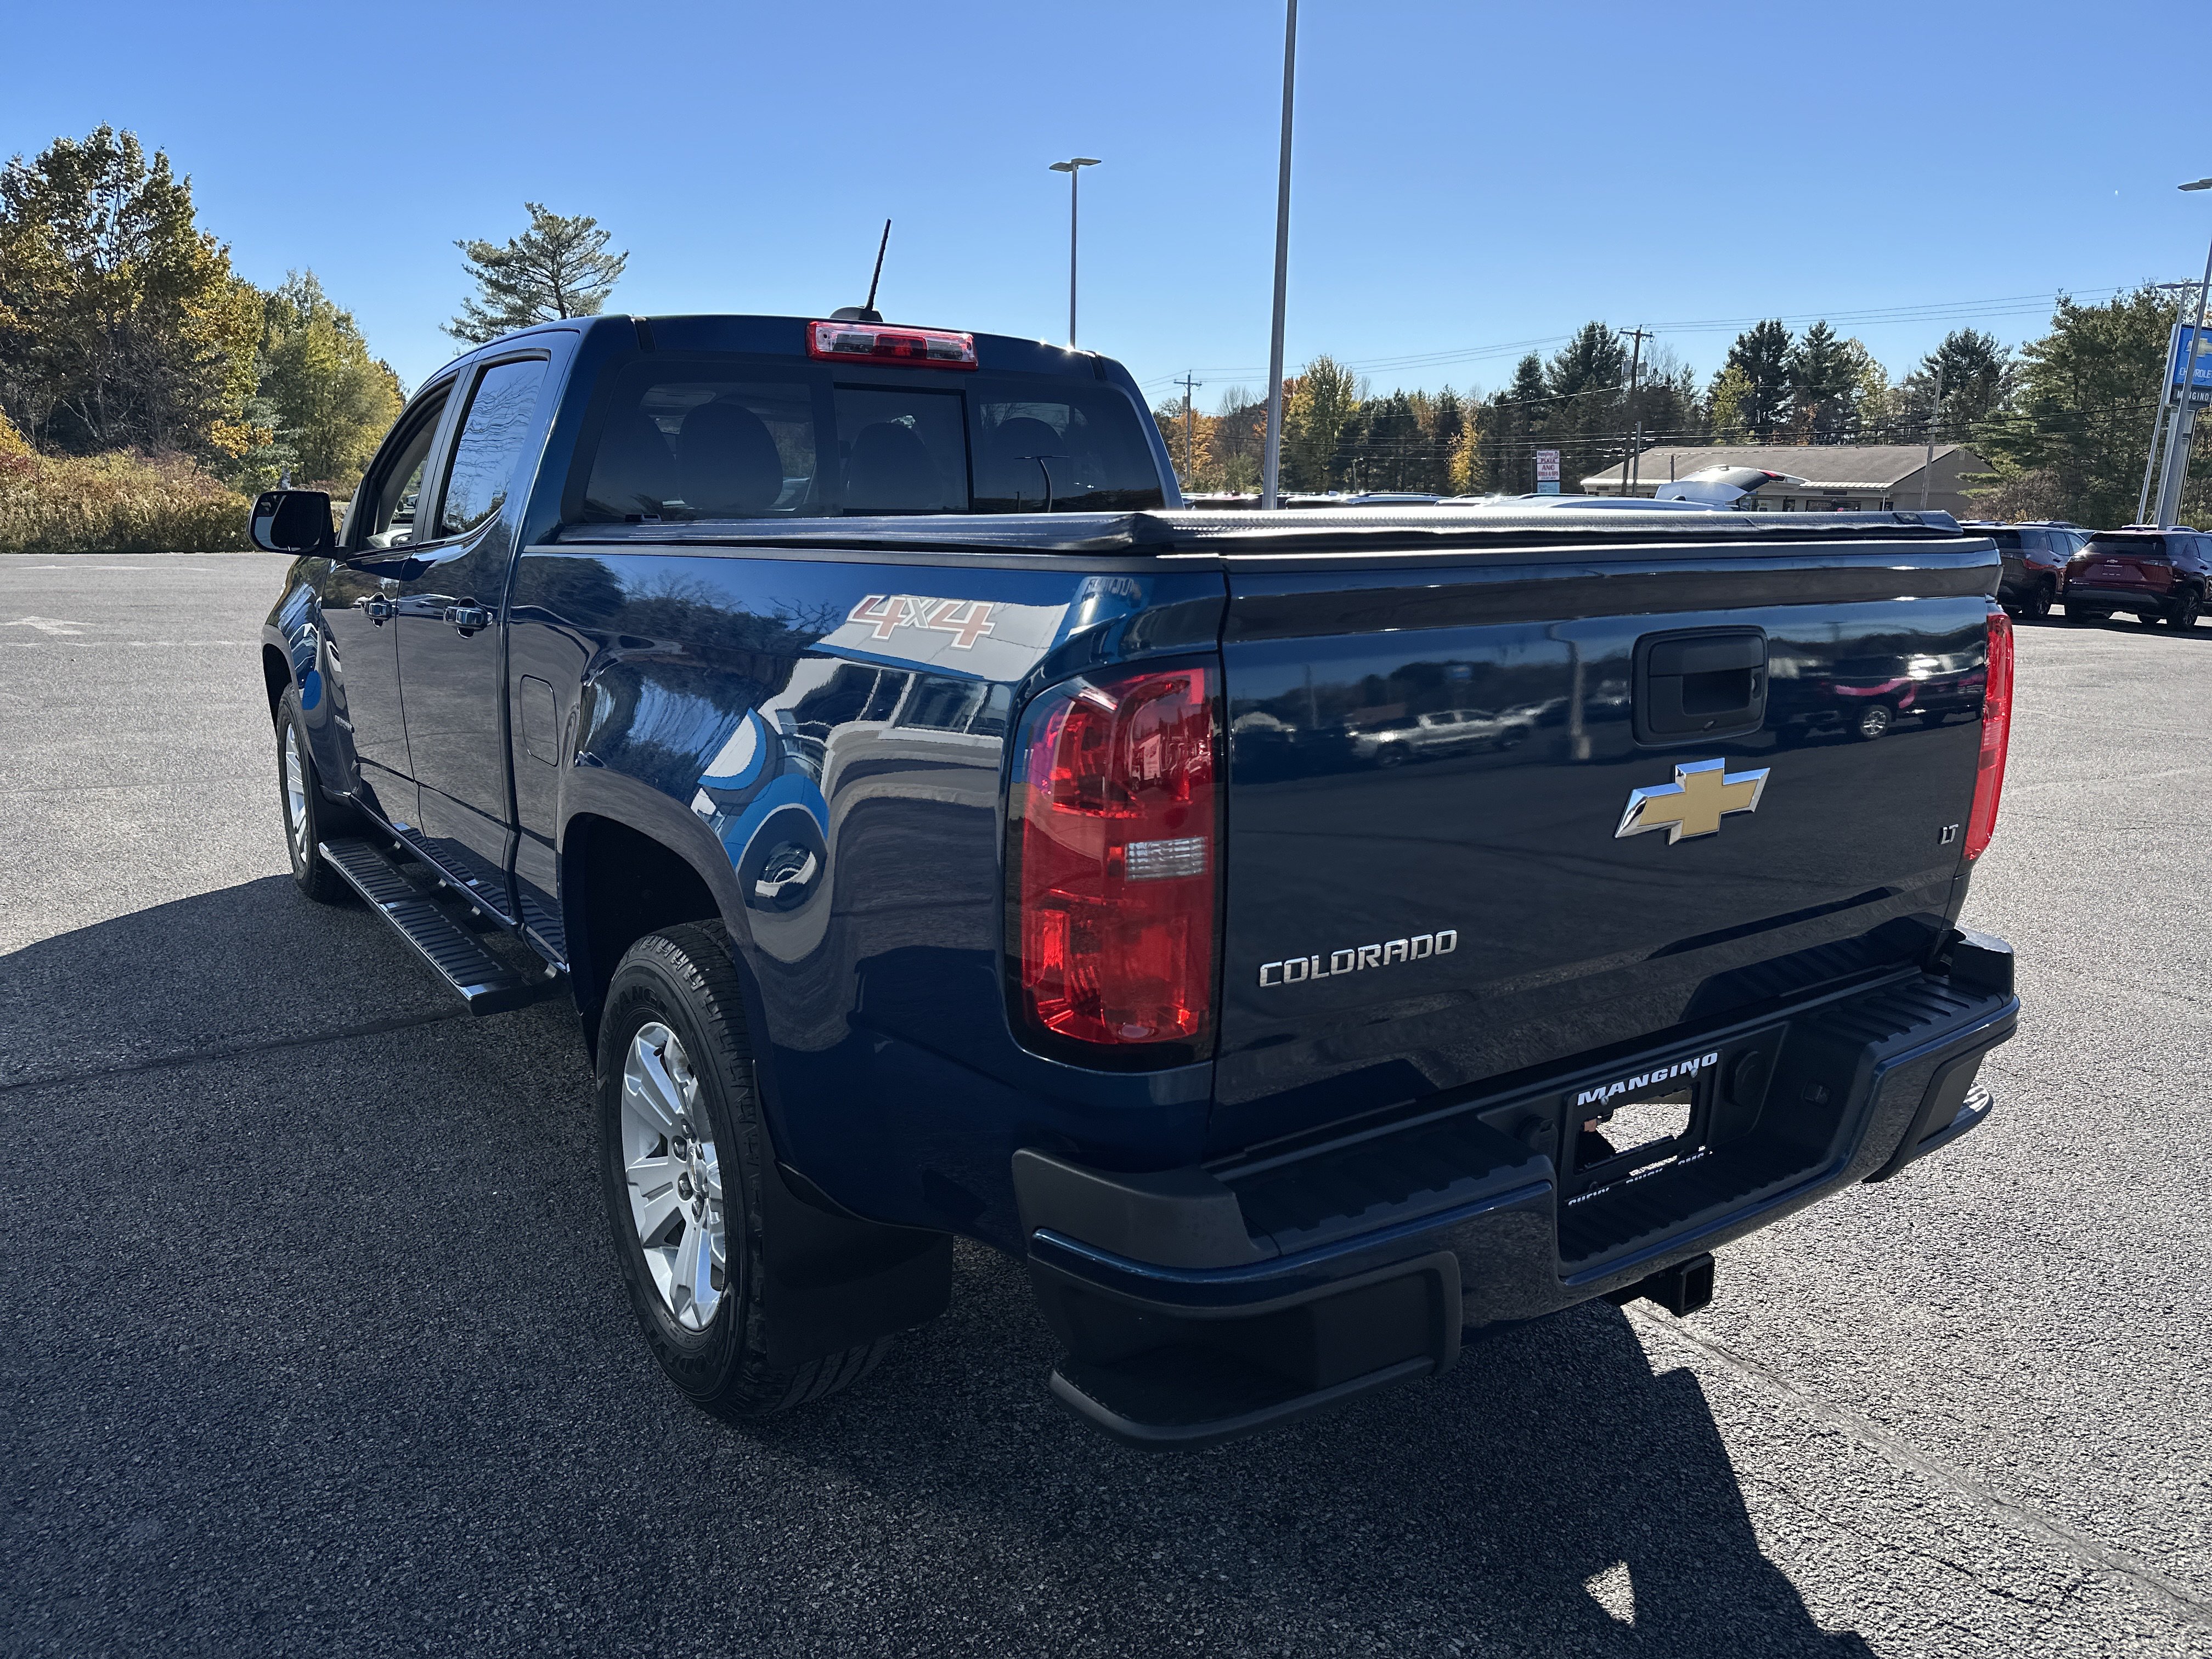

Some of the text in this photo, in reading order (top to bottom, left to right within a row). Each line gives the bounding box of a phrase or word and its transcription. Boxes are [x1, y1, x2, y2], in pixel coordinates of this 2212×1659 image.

[2179, 367, 2212, 379] CHROLE
[2177, 390, 2209, 401] MGINO
[1941, 823, 1959, 844] LT
[1260, 929, 1457, 988] COLORADO
[1577, 1052, 1718, 1106] MANGINO
